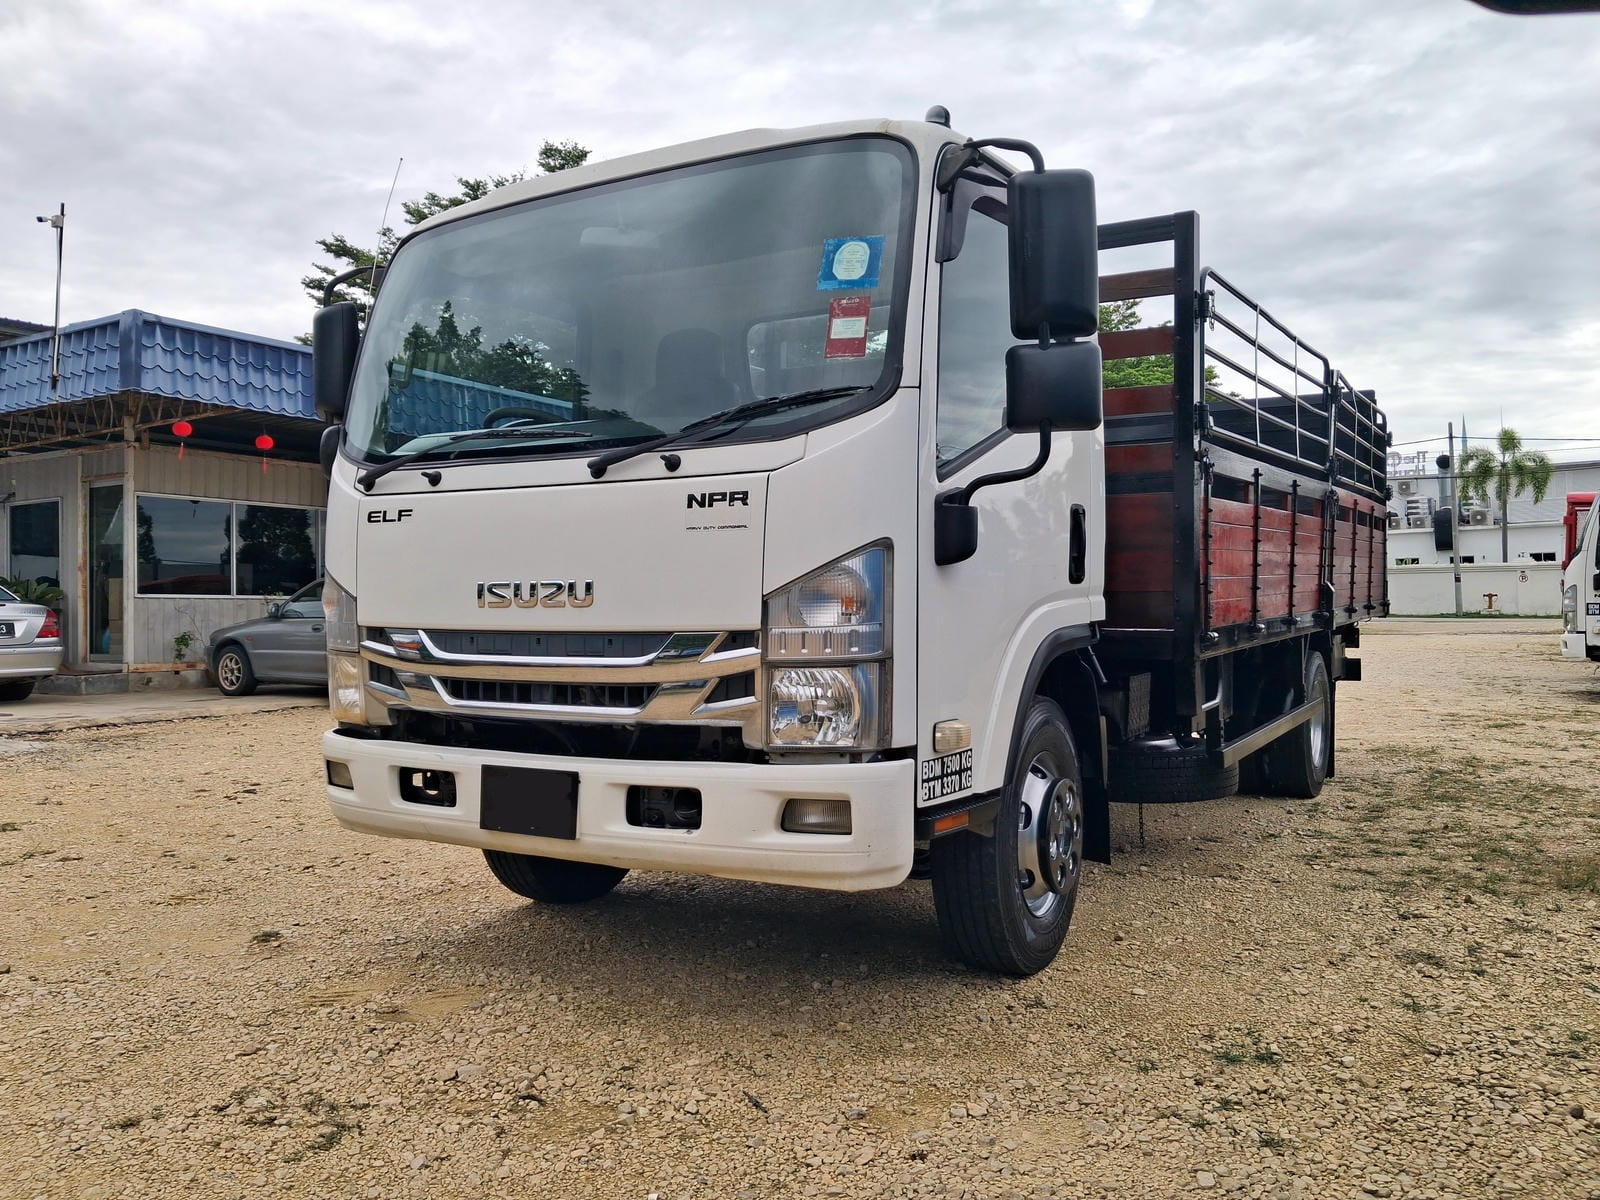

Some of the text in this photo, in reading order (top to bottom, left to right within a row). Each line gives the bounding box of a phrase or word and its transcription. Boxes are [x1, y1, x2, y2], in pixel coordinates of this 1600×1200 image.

[687, 490, 749, 509] NPR
[367, 508, 413, 523] ELF
[476, 579, 594, 608] ISUZU
[922, 750, 972, 780] BDM 7500 KG
[922, 770, 972, 801] BTM 3370 KG
